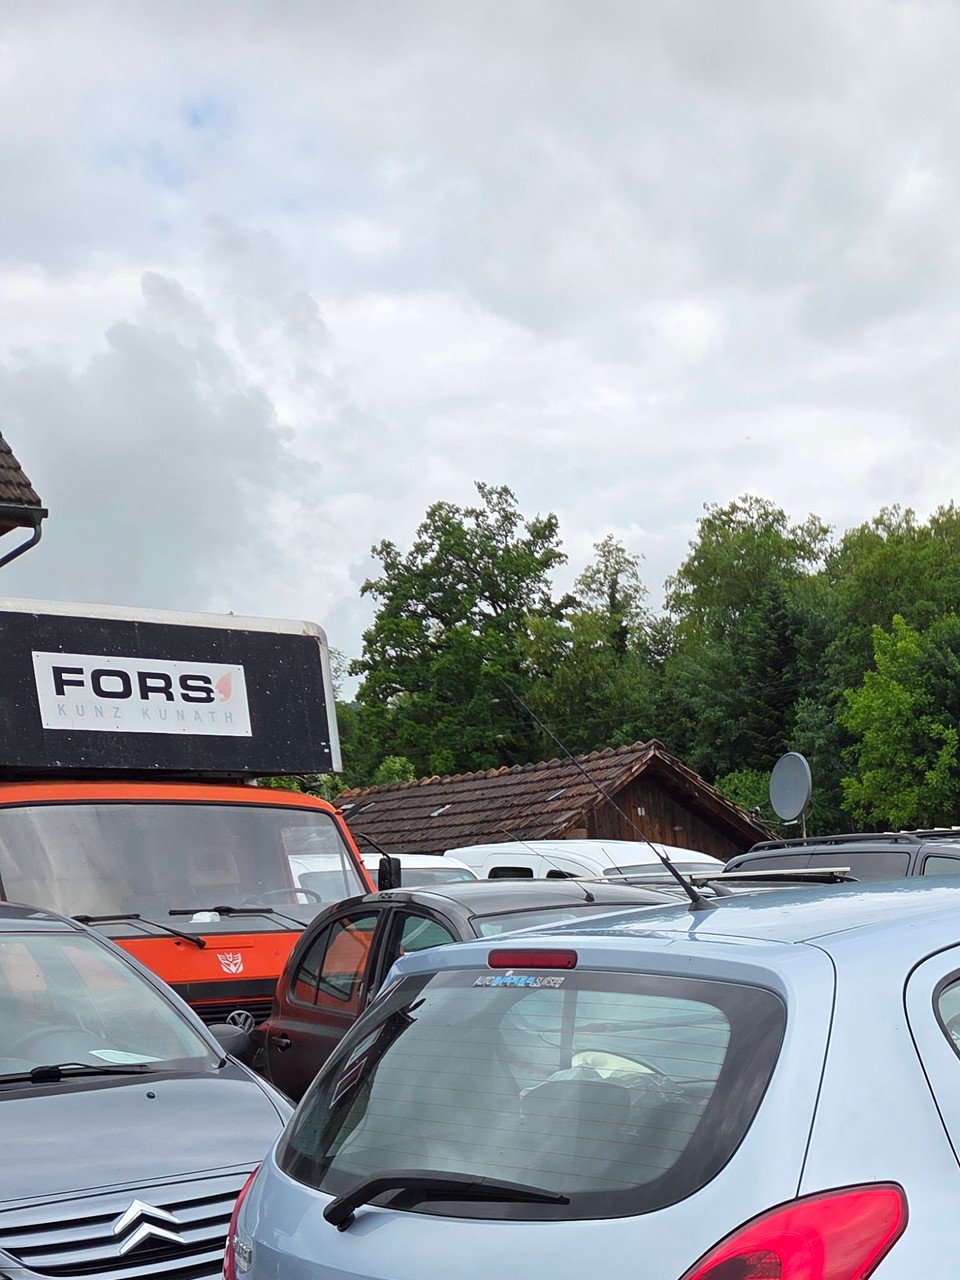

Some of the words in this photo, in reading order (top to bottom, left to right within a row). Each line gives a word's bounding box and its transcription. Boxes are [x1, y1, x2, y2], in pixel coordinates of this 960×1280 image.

[51, 665, 215, 703] FORS
[57, 703, 122, 719] KUNZ
[141, 707, 234, 724] KUNATH
